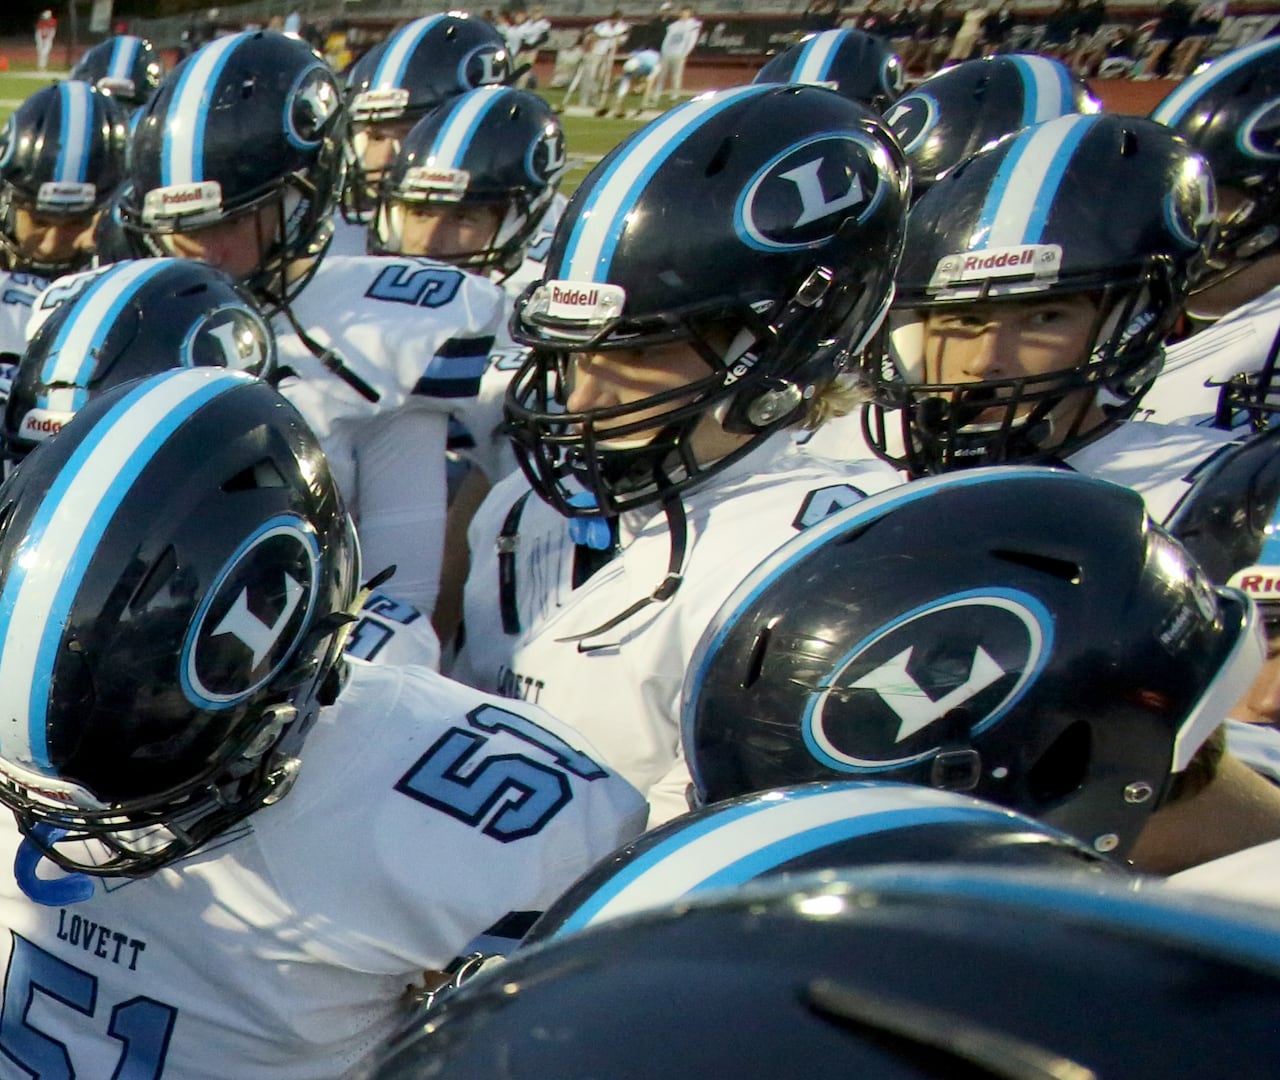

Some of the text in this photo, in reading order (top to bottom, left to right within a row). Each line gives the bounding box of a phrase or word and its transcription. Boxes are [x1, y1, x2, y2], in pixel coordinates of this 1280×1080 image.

[477, 54, 504, 83] L
[539, 137, 565, 171] L
[162, 188, 203, 204] Riddell
[778, 156, 865, 229] L
[964, 250, 1035, 271] Riddell
[552, 287, 599, 307] Riddell
[212, 571, 303, 672] L
[848, 645, 1005, 743] L
[393, 702, 610, 845] 51
[56, 906, 146, 972] LOVETT
